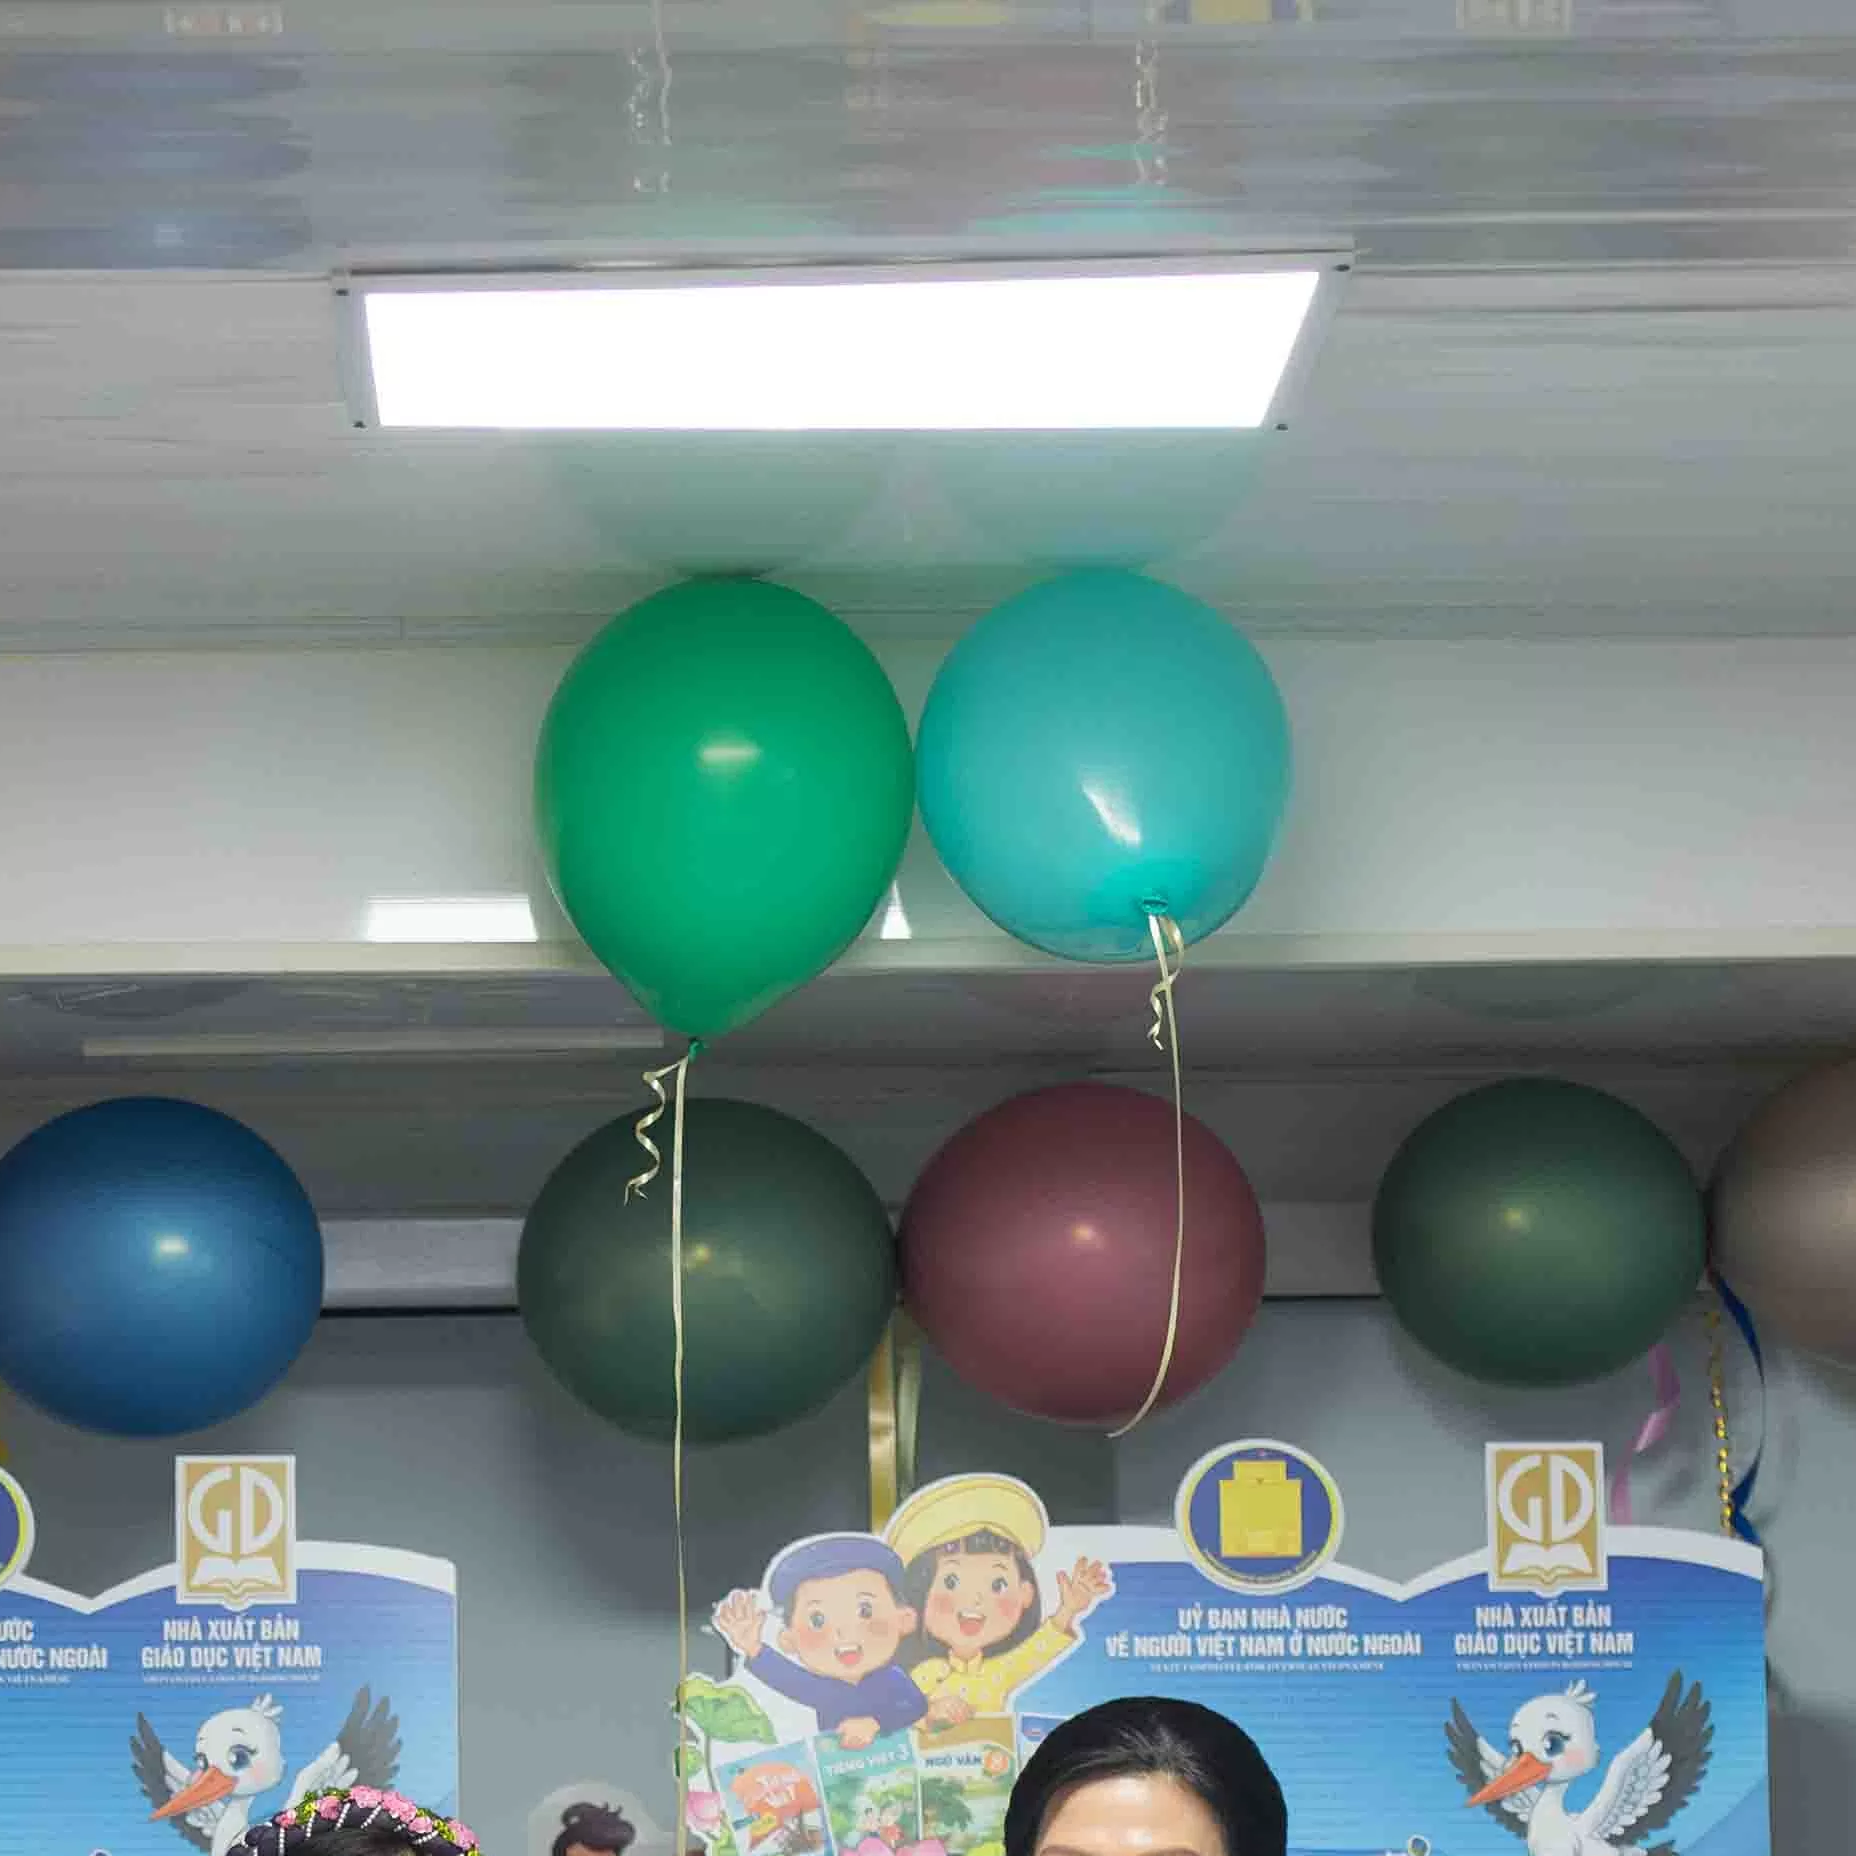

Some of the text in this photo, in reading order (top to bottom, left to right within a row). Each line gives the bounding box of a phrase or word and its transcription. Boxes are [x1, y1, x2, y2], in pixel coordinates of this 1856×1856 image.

[188, 1464, 283, 1555] GD
[1497, 1453, 1595, 1545] GD
[163, 1615, 204, 1641] NHÀ
[208, 1613, 256, 1640] XUẤT
[1207, 1609, 1247, 1630] BAN
[1252, 1605, 1291, 1629] NHÀ
[1475, 1603, 1514, 1628] NHÀ
[1519, 1601, 1567, 1628] XUẤT
[47, 1643, 108, 1669] NGOÀI
[141, 1641, 322, 1673] GIÁO DỤC VIỆT NAM
[1196, 1631, 1236, 1661] VIỆT
[1240, 1635, 1284, 1657] NAM
[1363, 1630, 1422, 1656] NGOÀI
[1455, 1628, 1634, 1660] GIÁO DỤC VIỆT NAM
